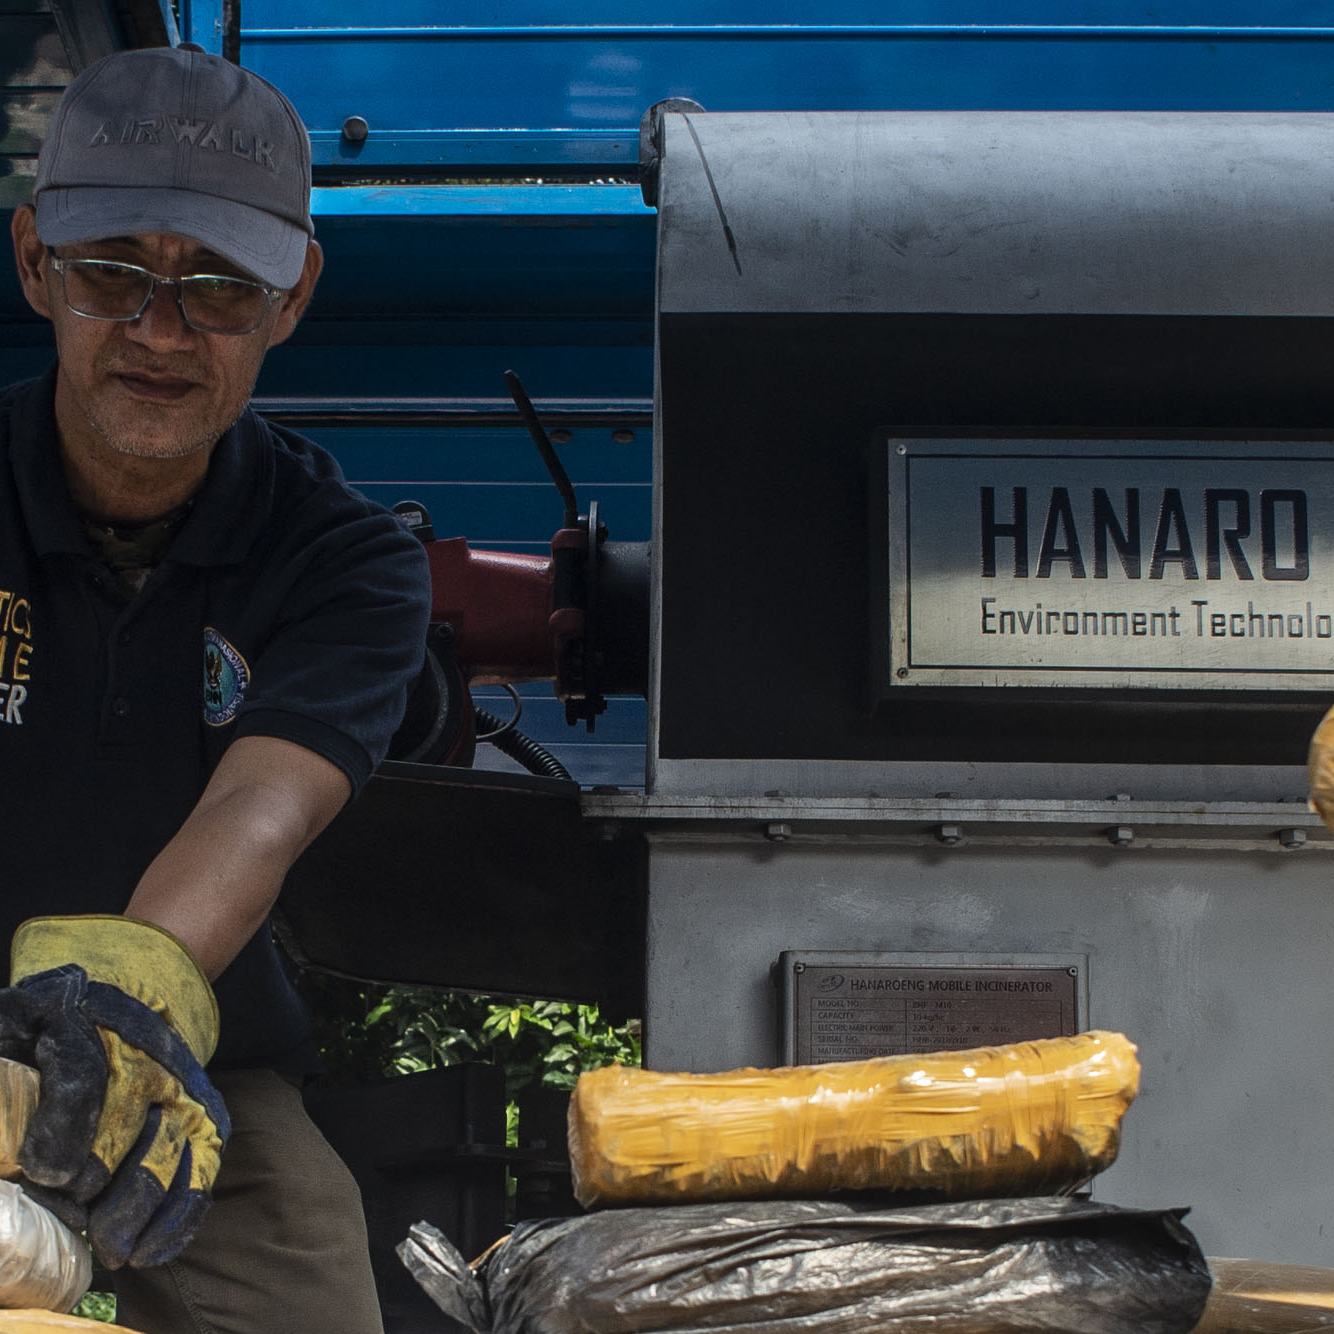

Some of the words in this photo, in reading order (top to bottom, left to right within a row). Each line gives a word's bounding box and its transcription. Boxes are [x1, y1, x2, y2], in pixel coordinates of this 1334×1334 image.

[90, 114, 276, 173] AIRWALK
[980, 486, 1310, 581] HANARO
[980, 597, 1181, 637] Environment
[850, 979, 925, 992] HANAROENG
[928, 980, 972, 992] MOBILE
[975, 980, 1053, 993] INCINERATOR
[817, 1012, 855, 1020] CAPACITY
